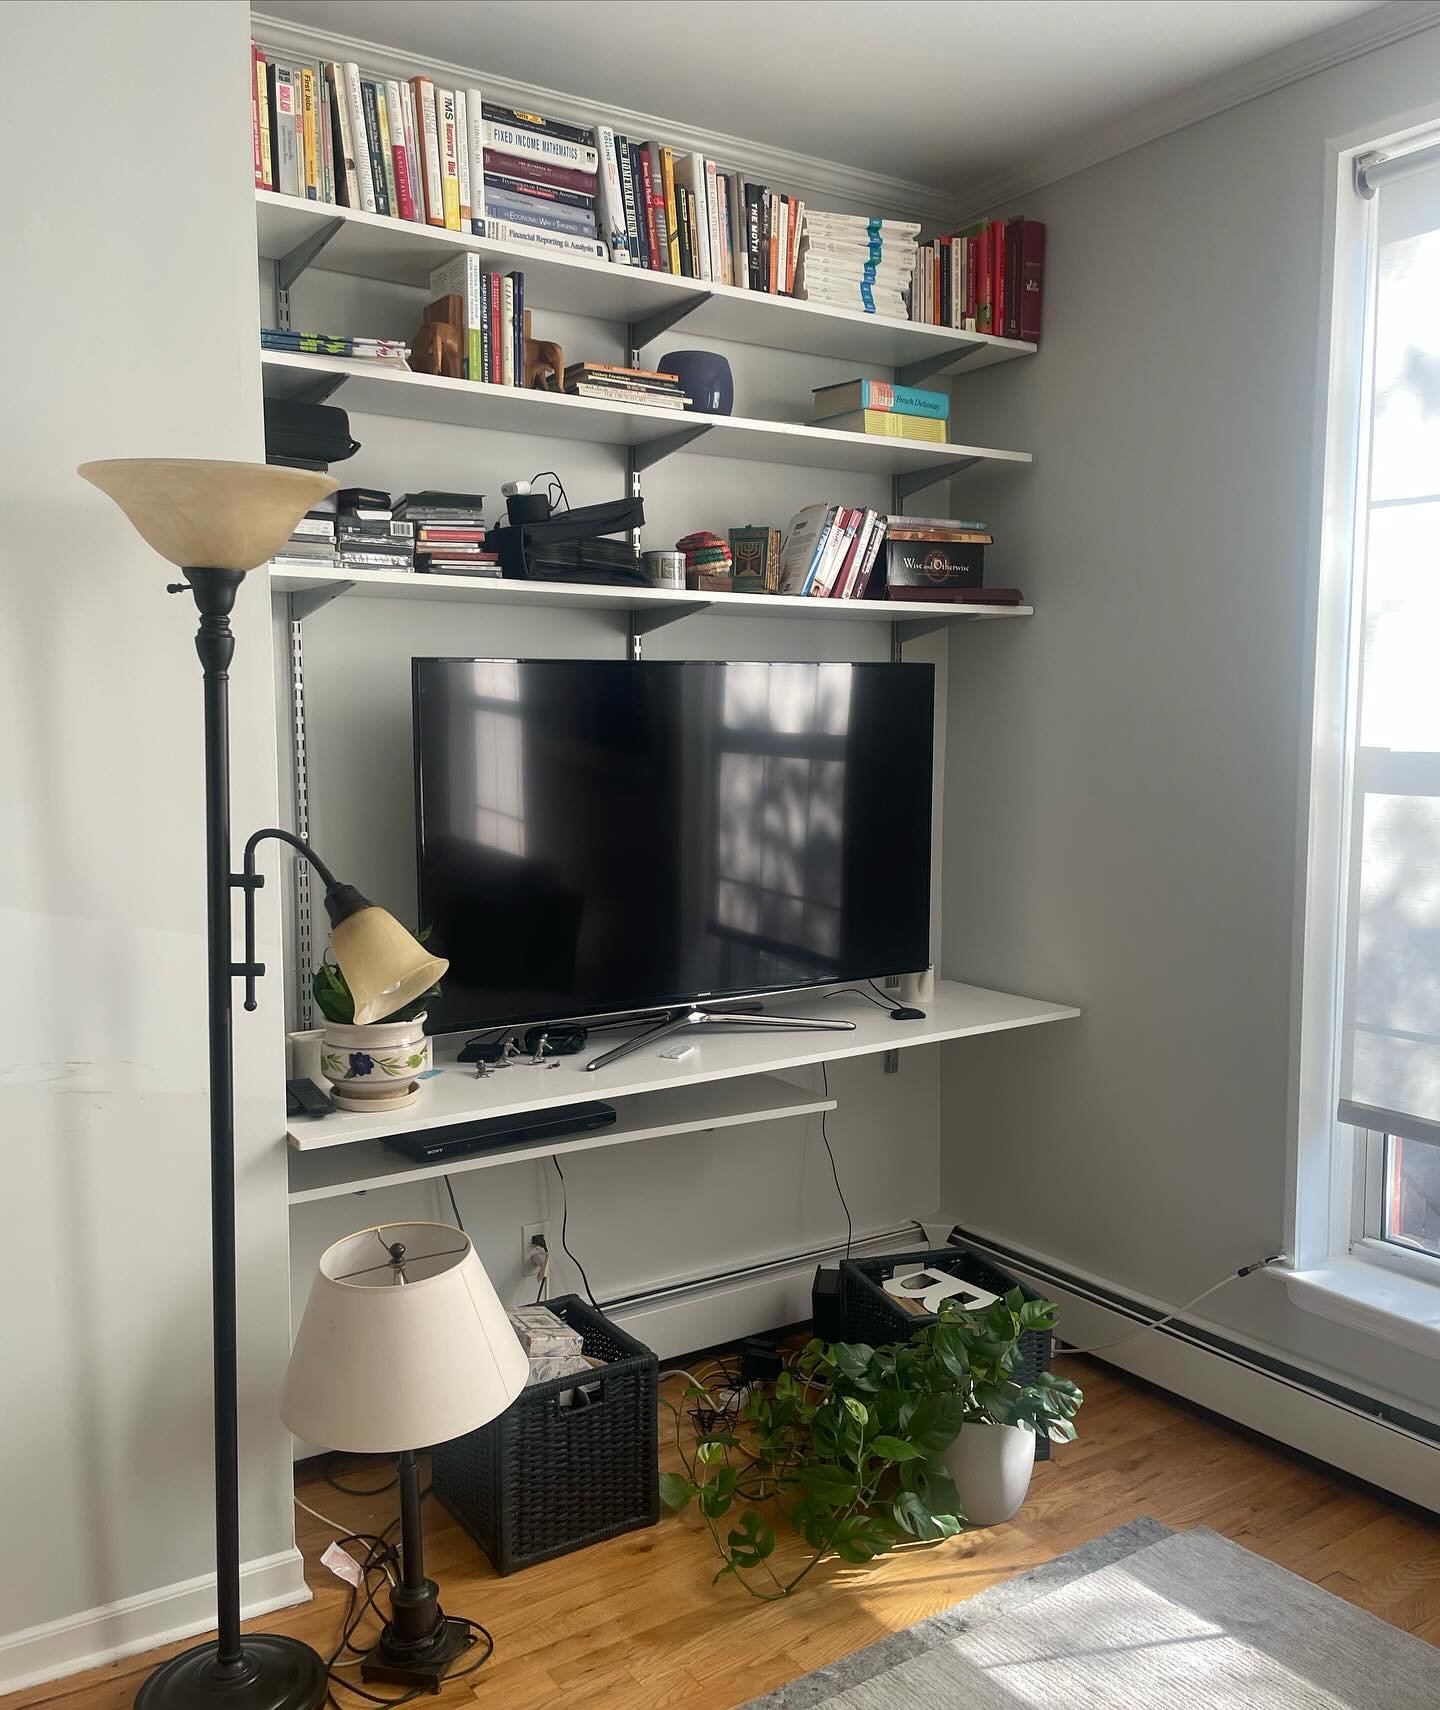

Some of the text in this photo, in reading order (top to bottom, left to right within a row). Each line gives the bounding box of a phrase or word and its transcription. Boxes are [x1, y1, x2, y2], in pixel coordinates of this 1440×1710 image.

[352, 94, 360, 120] HARRIS
[444, 101, 453, 120] MS
[445, 123, 454, 157] Recovery
[494, 128, 578, 160] FIXED INCOME MATHEMATICS
[447, 160, 455, 176] Diet
[474, 153, 480, 164] MS
[396, 150, 407, 201] NANCY DAVIS
[621, 156, 637, 238] HOMEWARD BOUND
[509, 229, 535, 241] Financial
[536, 234, 563, 248] Reporting
[564, 239, 569, 247] &
[570, 242, 594, 253] Analysis
[751, 224, 759, 252] MOTH
[897, 395, 914, 406] French
[915, 398, 940, 412] Dictionary
[902, 557, 922, 568] Wise
[933, 558, 969, 572] Otherwise
